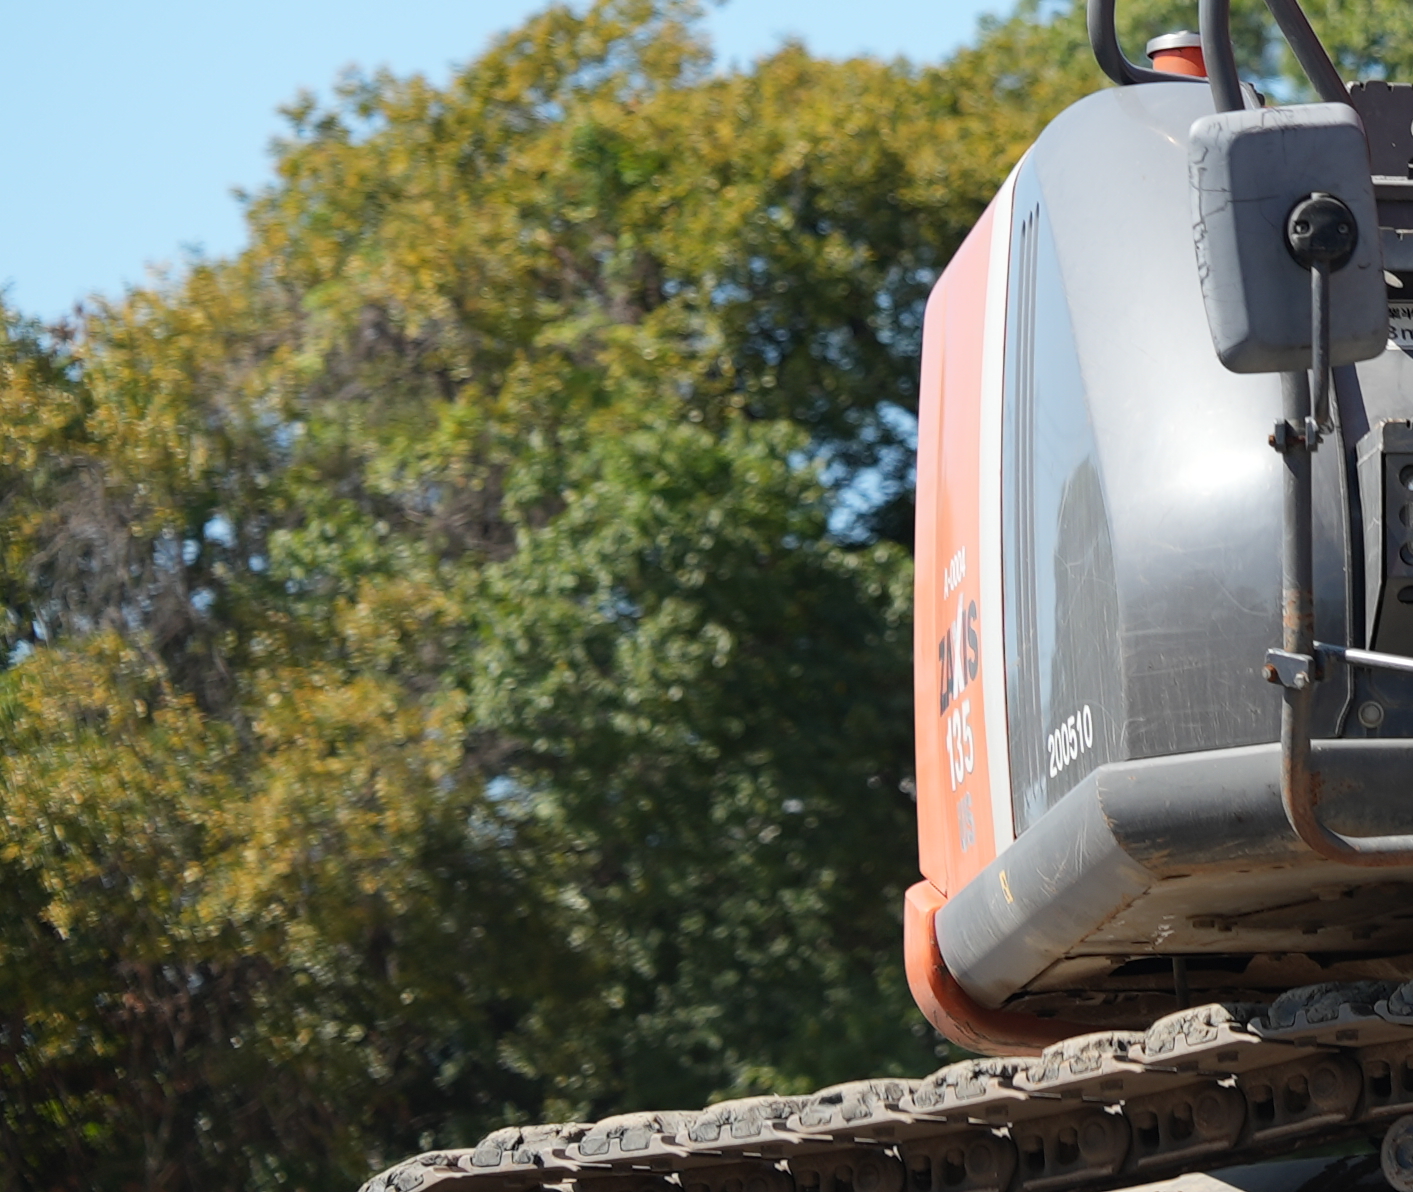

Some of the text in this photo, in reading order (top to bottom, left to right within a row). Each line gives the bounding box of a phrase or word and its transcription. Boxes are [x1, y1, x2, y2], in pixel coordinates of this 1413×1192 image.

[938, 592, 979, 718] ZAXIS
[946, 698, 974, 793] 135
[1048, 704, 1093, 779] 200510
